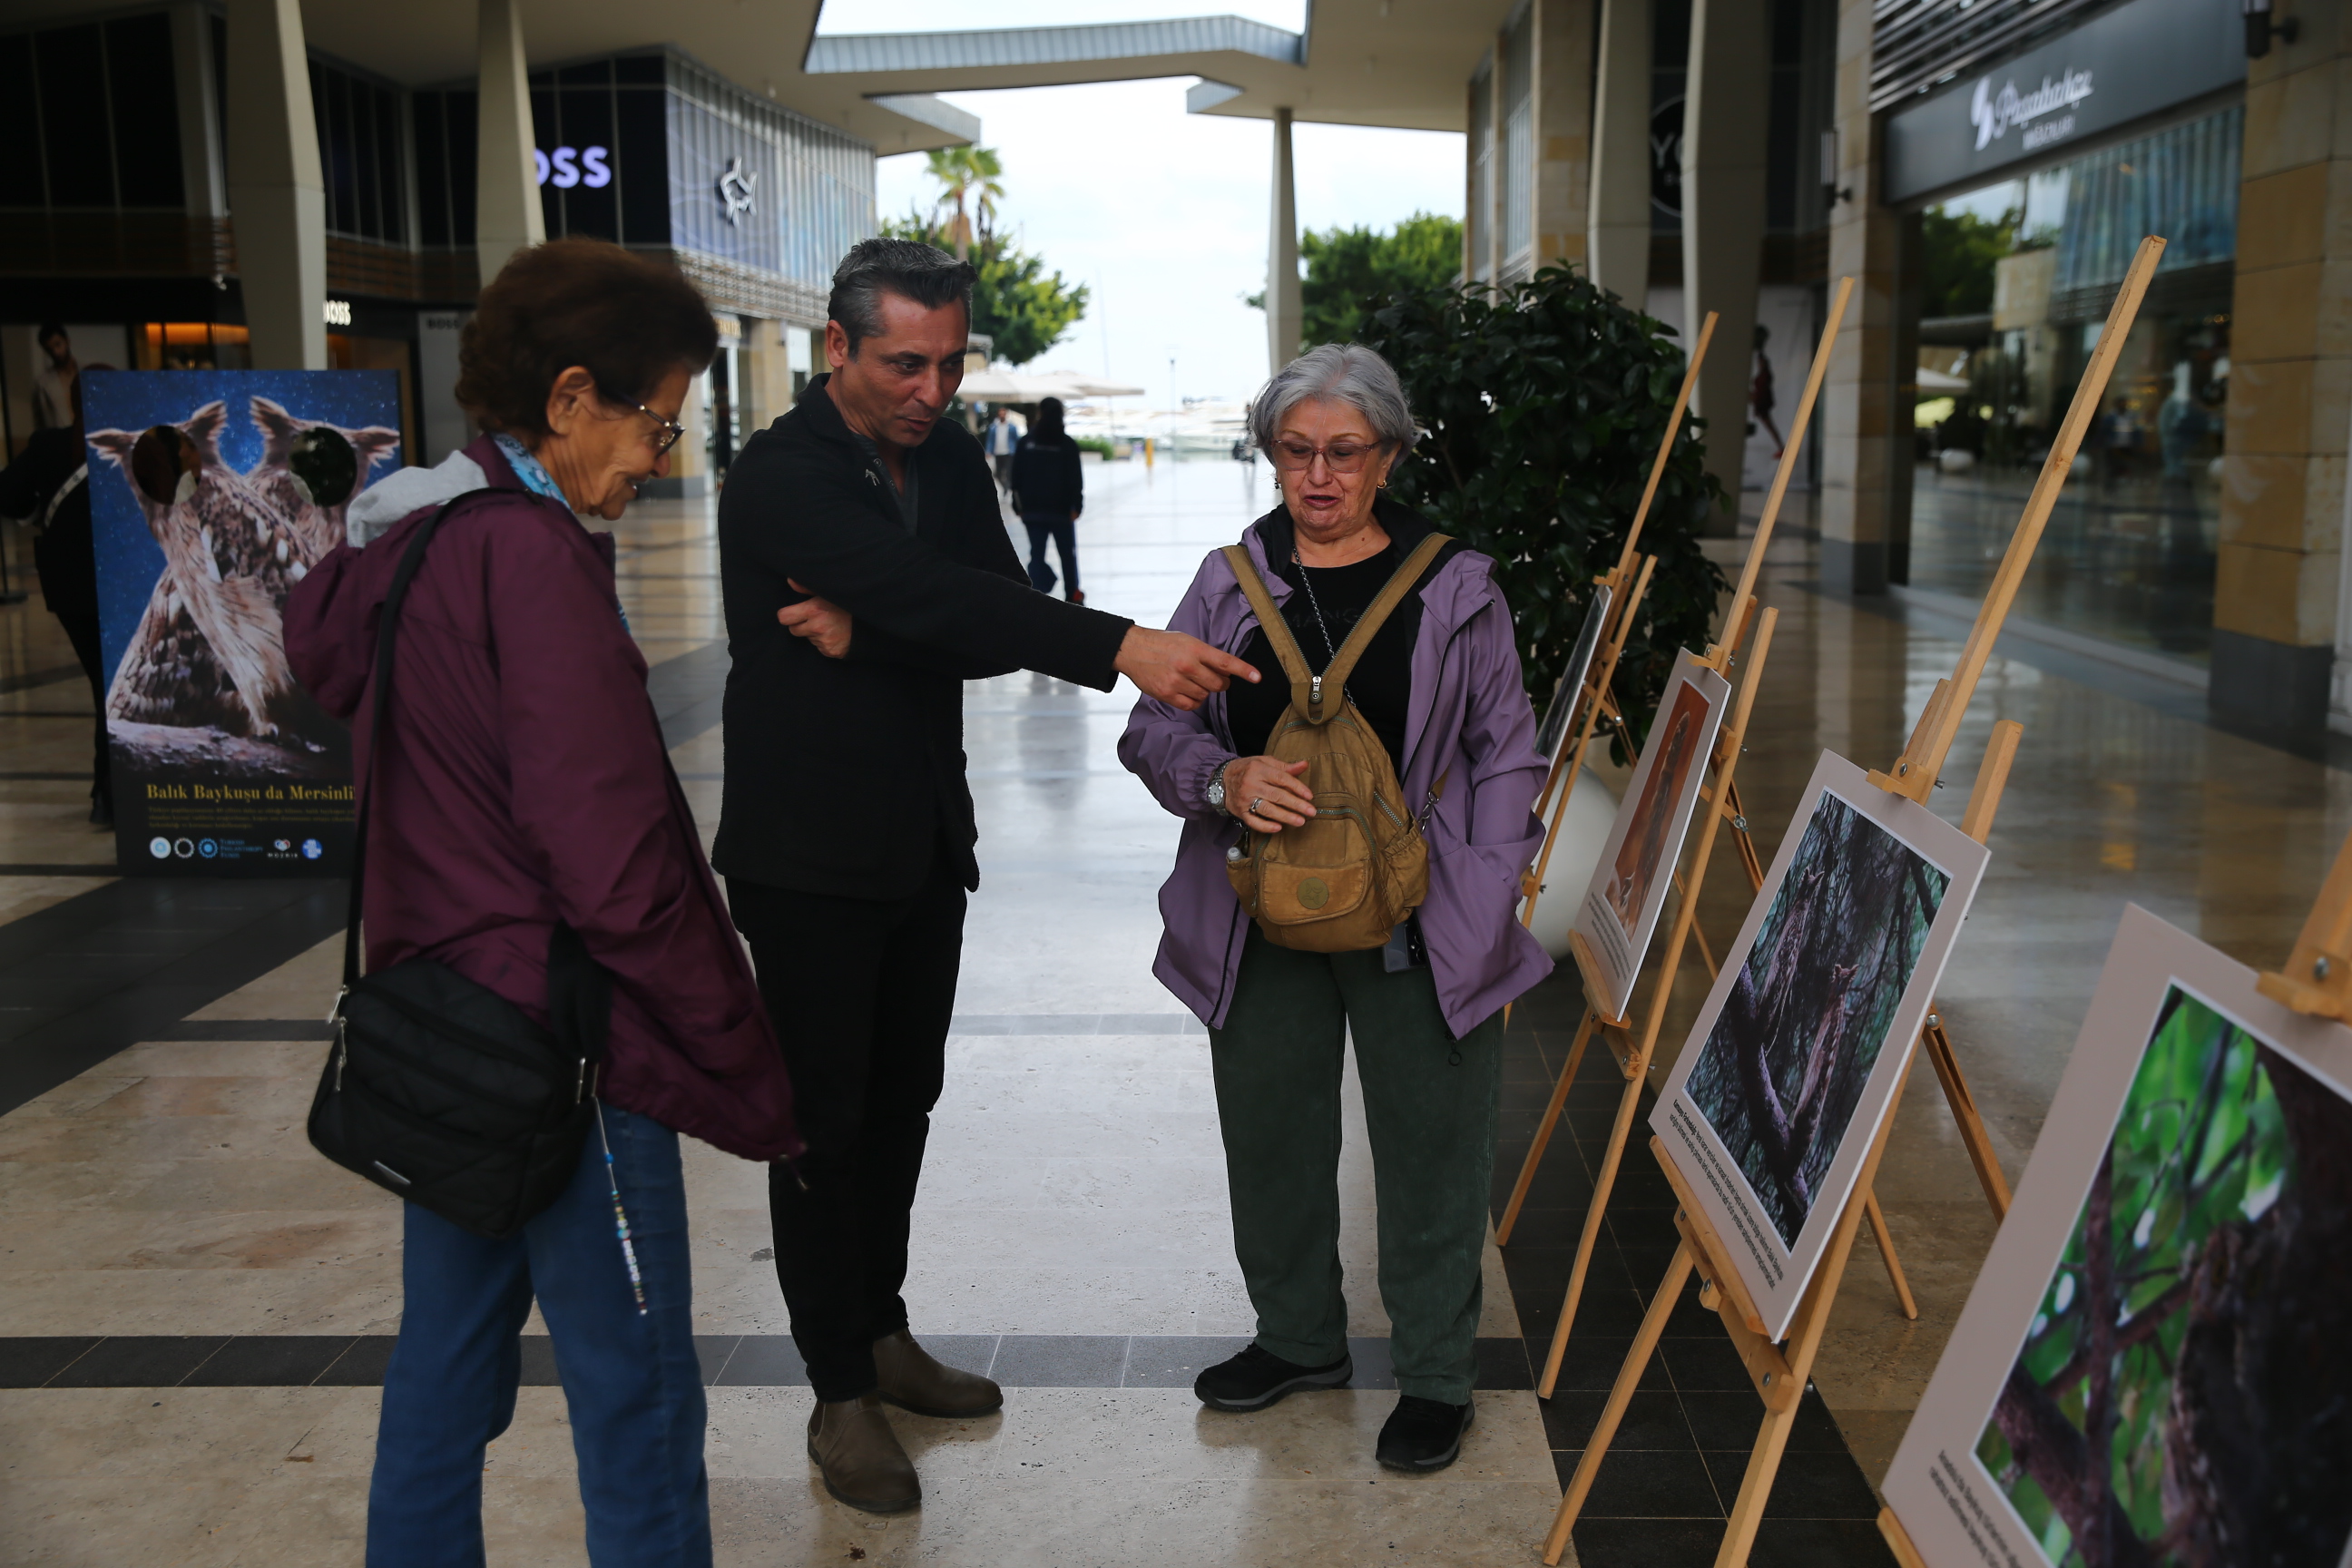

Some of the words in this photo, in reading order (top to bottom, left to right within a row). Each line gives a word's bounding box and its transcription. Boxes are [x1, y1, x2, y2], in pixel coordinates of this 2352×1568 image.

[1650, 131, 1682, 169] Y
[147, 784, 188, 799] Balık
[193, 784, 260, 803] Baykuşu
[265, 785, 284, 799] da
